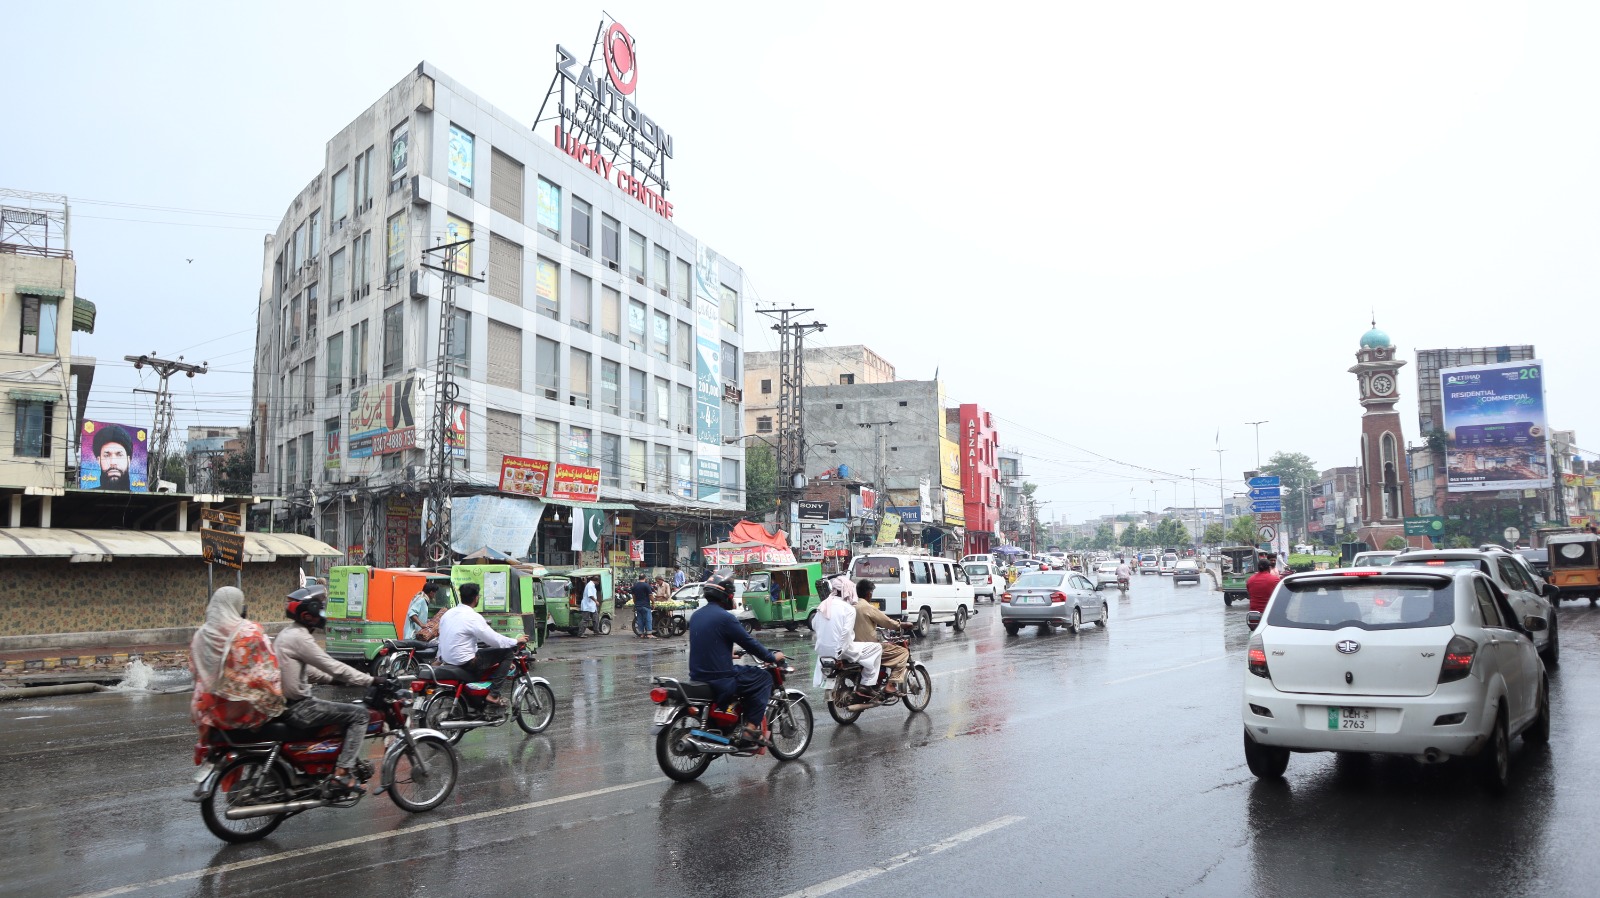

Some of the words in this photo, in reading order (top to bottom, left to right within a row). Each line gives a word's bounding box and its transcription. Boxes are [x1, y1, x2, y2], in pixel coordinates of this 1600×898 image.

[556, 44, 673, 159] ZAITOON
[555, 124, 613, 181] LUCKY
[618, 170, 674, 220] CENTRE
[385, 377, 415, 430] UK
[706, 406, 711, 428] 4
[1452, 390, 1496, 399] RESIDENTIAL
[1482, 394, 1530, 403] COMMERCIAL
[968, 420, 976, 467] AFZAL
[1343, 720, 1365, 729] 2763
